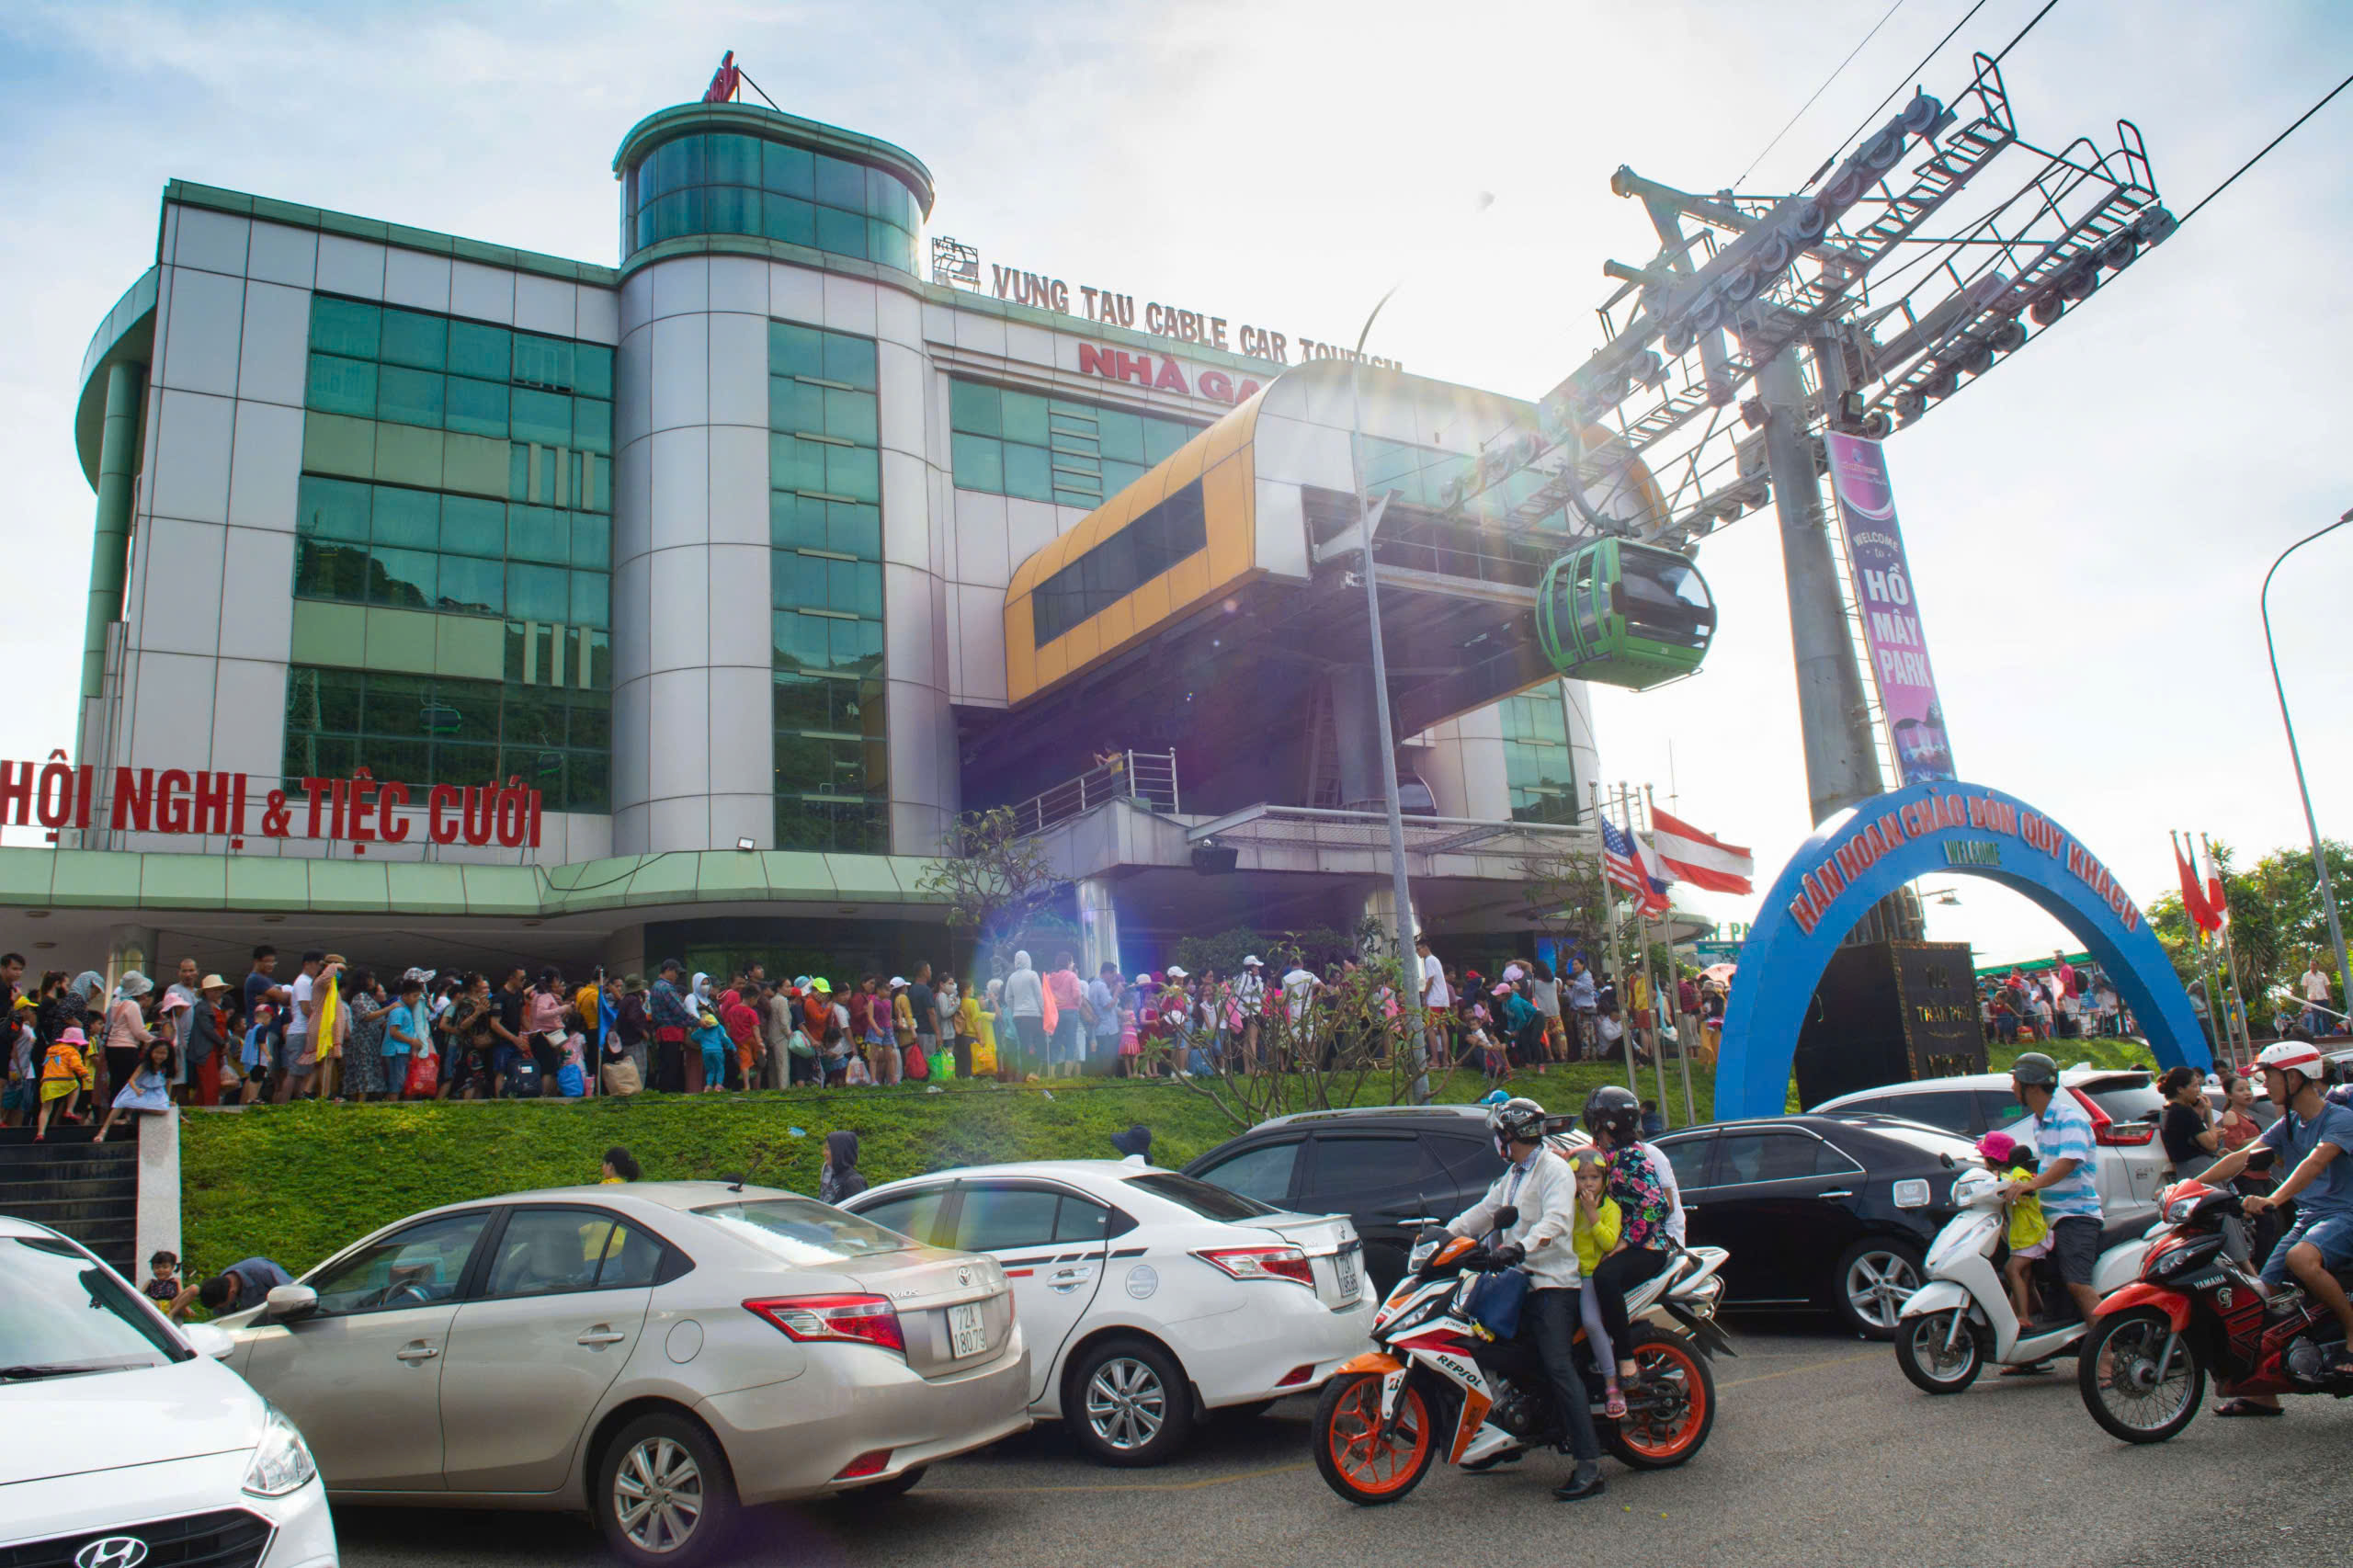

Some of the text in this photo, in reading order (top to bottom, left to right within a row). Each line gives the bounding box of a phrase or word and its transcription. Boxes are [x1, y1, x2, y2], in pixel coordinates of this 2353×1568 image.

[1080, 285, 1135, 327] TAU
[1145, 301, 1229, 350] CABLE
[1239, 324, 1289, 363] CAR
[1078, 343, 1190, 394] NHÀ
[1853, 531, 1899, 552] WELCOME
[1874, 548, 1884, 559] to
[1870, 608, 1919, 647] MÂY
[1878, 648, 1931, 687] PARK
[0, 748, 543, 855] HỘI NGHỊ & TIỆC CƯỚI
[1834, 812, 1905, 884] HOAN
[1942, 839, 2002, 866] WELCOME
[2194, 1274, 2227, 1290] YAMAHA
[956, 1305, 976, 1331] 72A
[1437, 1353, 1483, 1388] REPSOL
